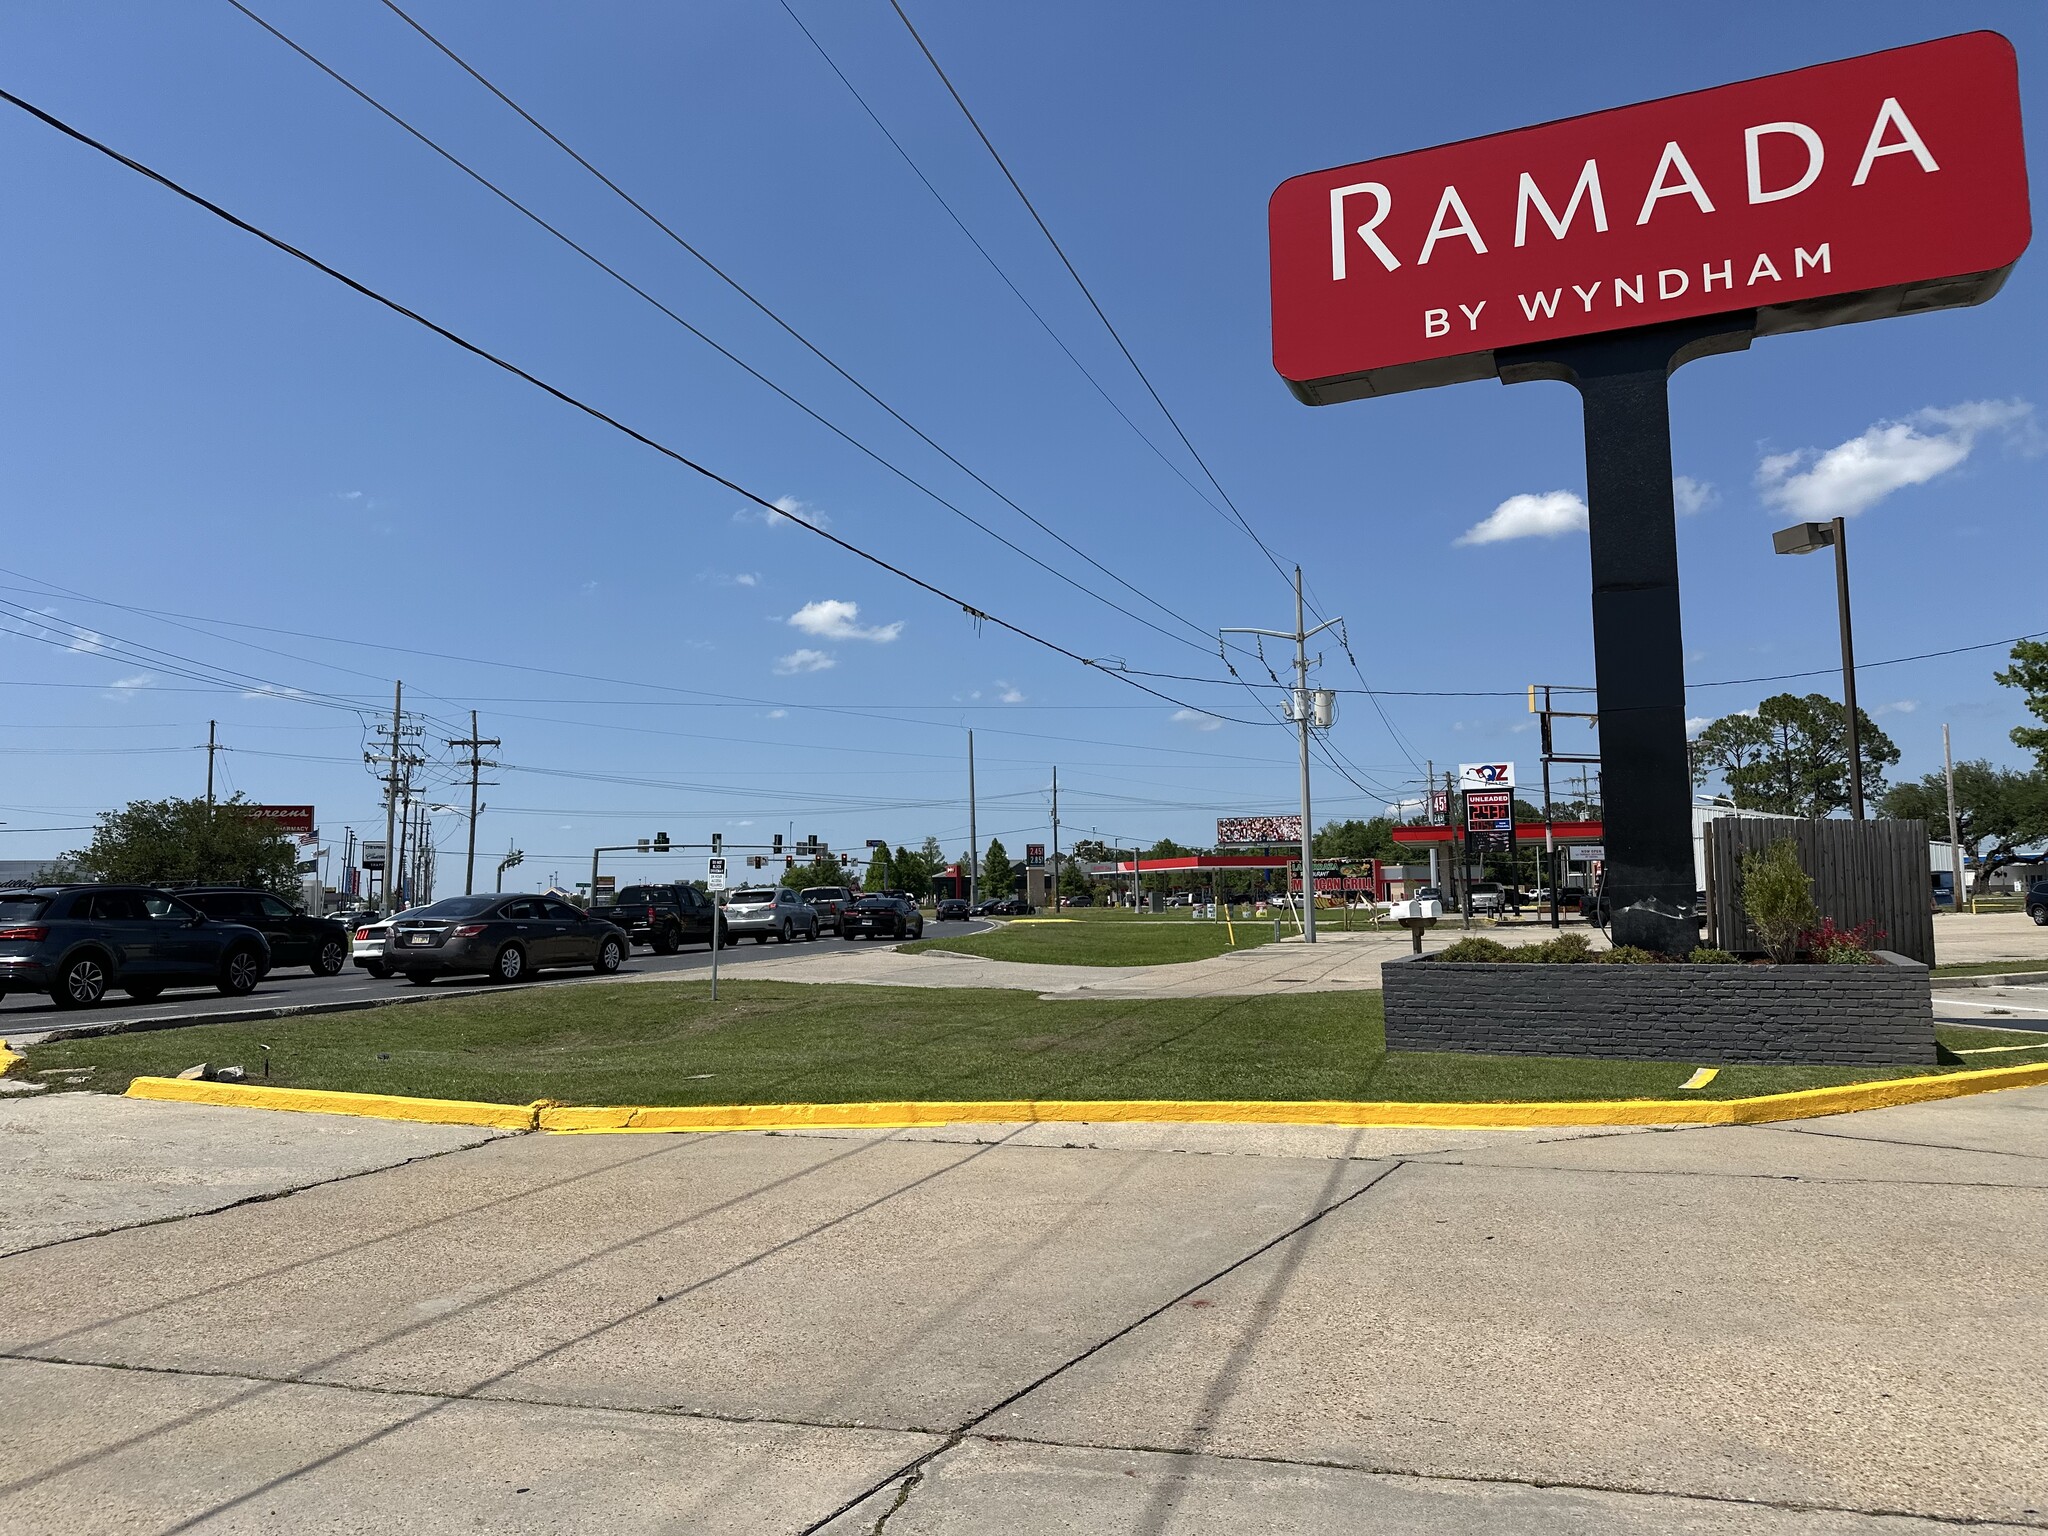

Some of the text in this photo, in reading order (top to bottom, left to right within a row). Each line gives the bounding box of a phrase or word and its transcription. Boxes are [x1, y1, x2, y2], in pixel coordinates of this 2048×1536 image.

[1329, 97, 1940, 282] RAMADA
[1424, 243, 1832, 339] BY WYNDHAM
[1469, 795, 1508, 803] UNLEADED
[1292, 877, 1372, 890] MICAN GRILL
